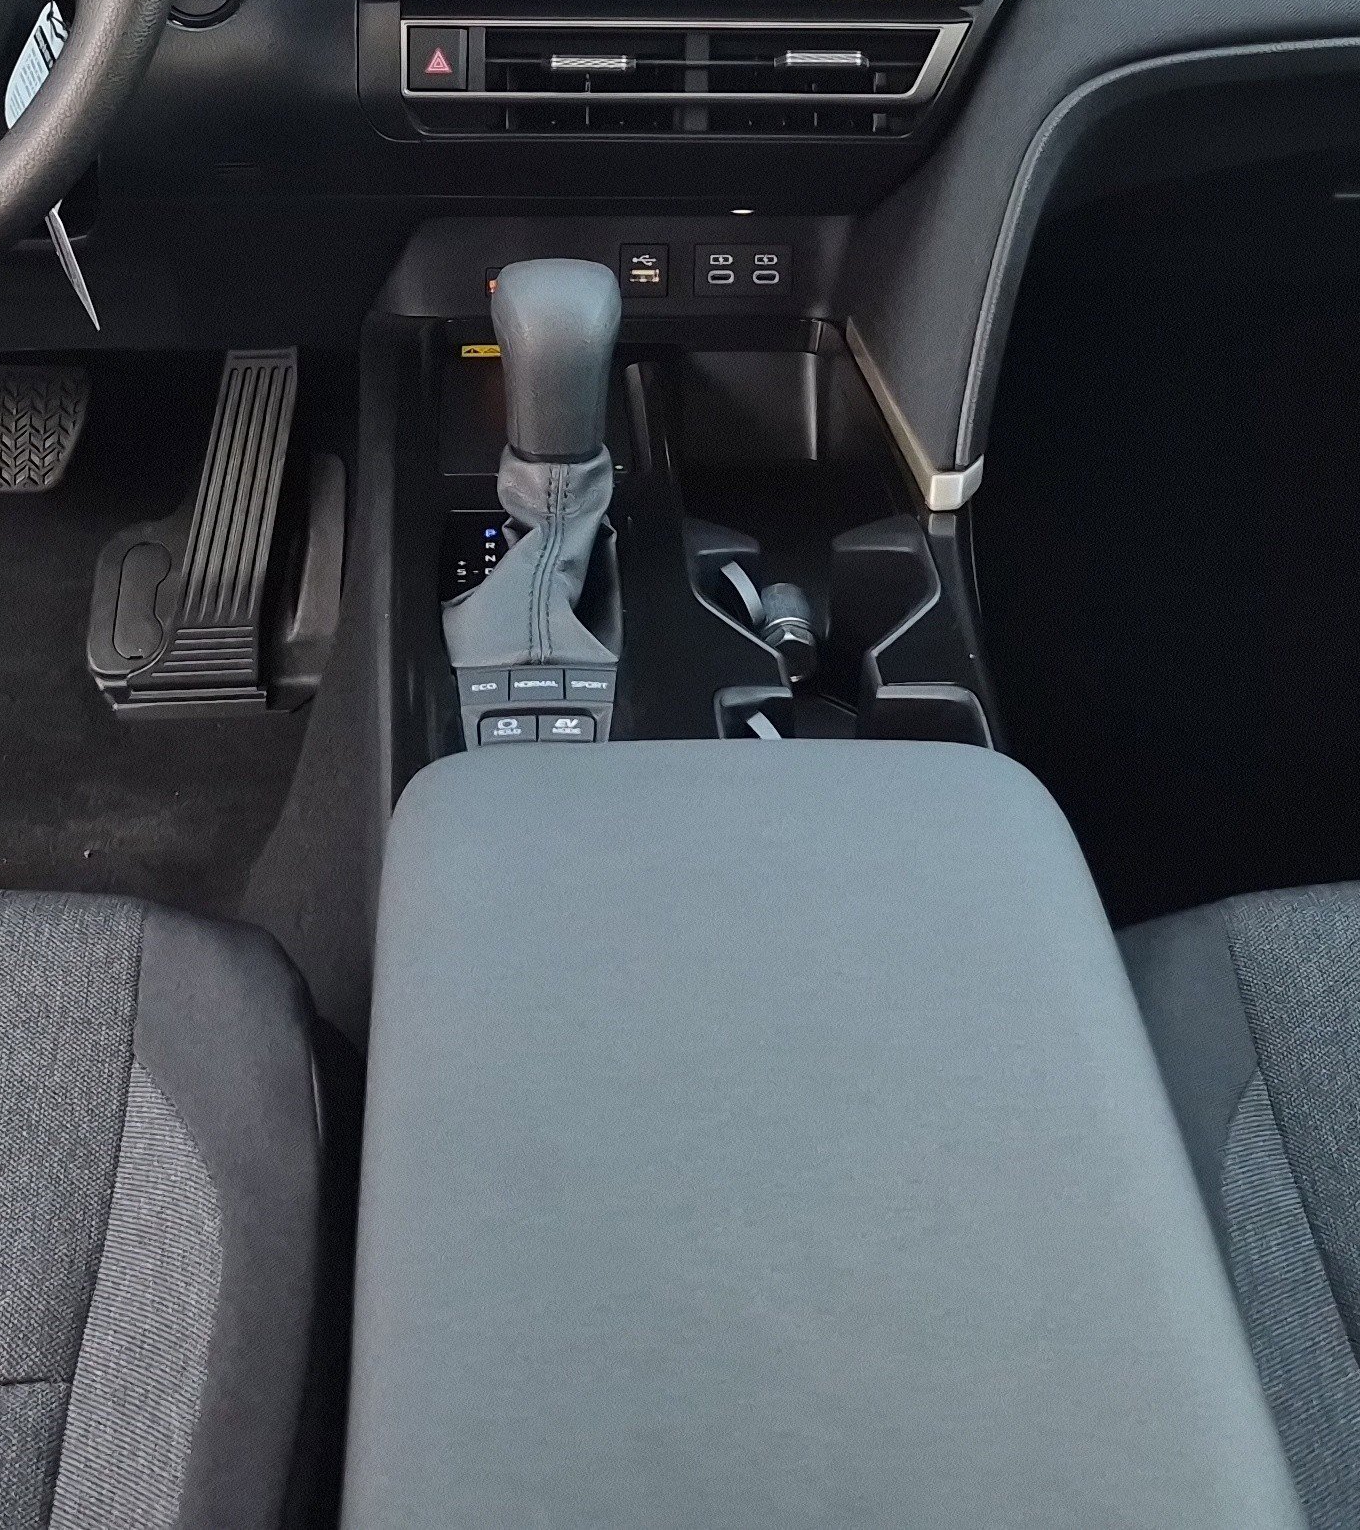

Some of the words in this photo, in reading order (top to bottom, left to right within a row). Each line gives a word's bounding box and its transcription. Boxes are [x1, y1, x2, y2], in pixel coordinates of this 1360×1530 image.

[485, 528, 497, 537] P
[485, 541, 496, 550] R
[485, 554, 496, 562] N
[471, 682, 498, 692] ECO
[514, 679, 559, 689] NORMAL
[570, 680, 609, 690] SPORT
[554, 718, 579, 728] EV
[552, 726, 582, 735] MODE
